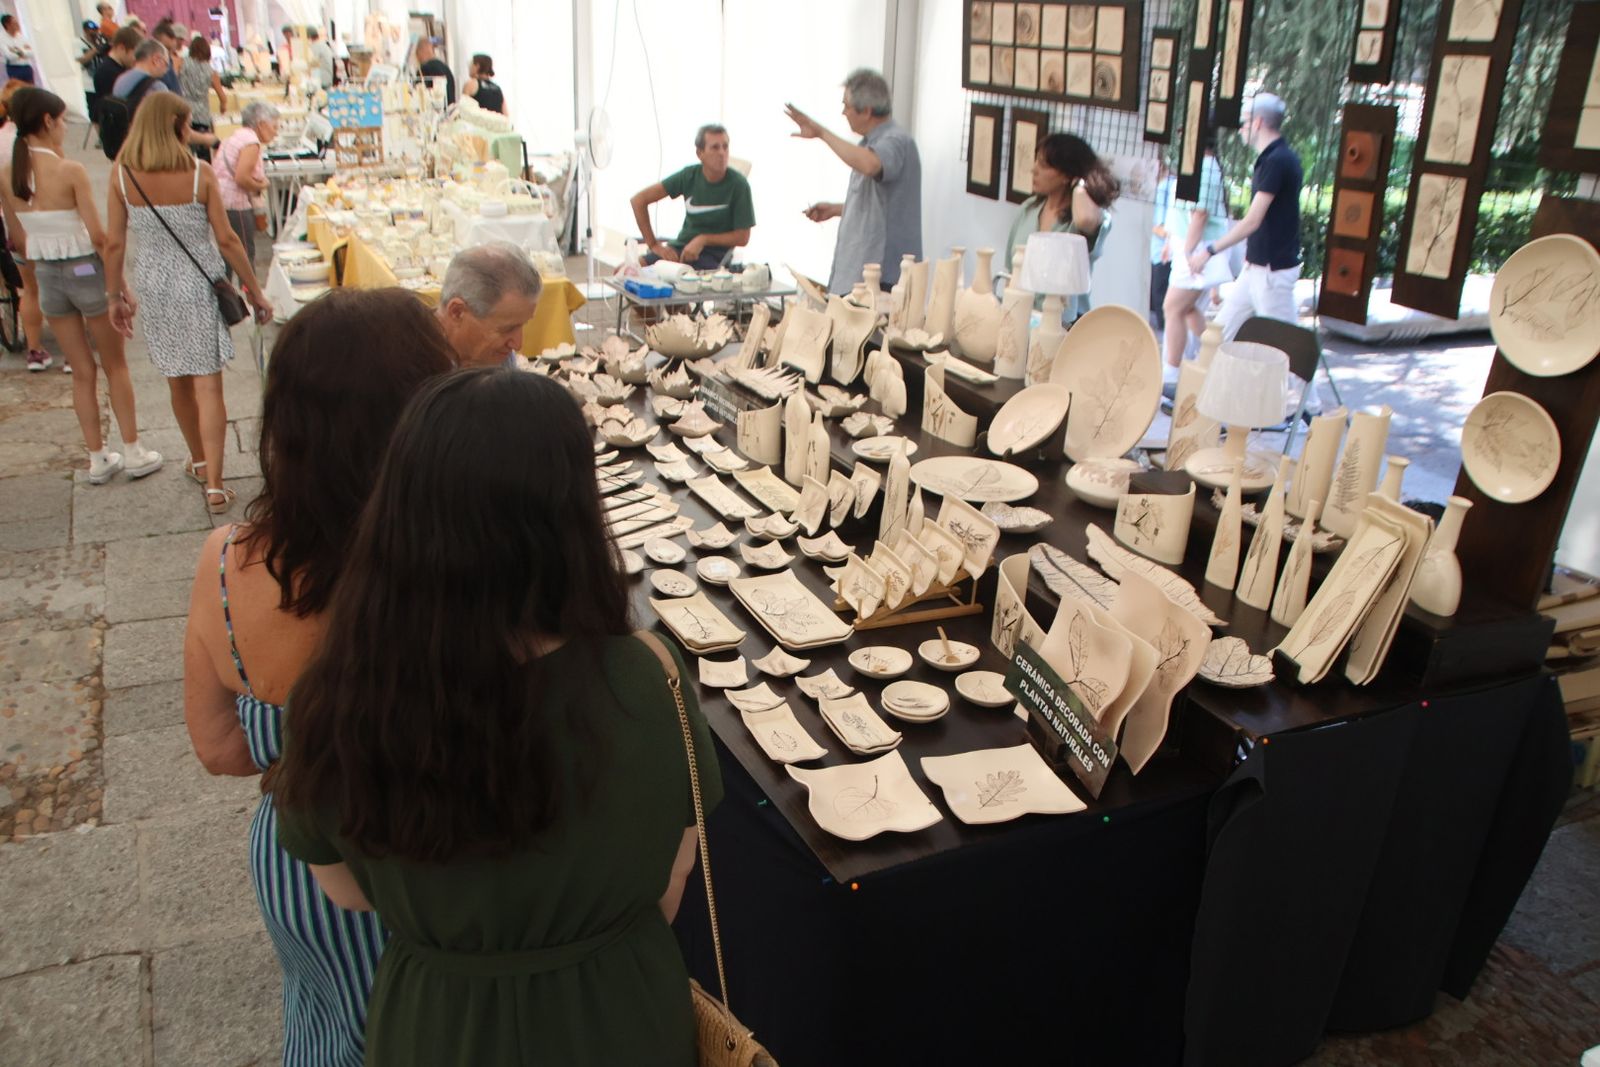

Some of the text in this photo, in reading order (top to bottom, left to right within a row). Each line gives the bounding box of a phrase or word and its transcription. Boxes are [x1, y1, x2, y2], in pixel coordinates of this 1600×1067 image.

[1015, 654, 1111, 769] CERÁMICA DECORADA CON
[1019, 679, 1095, 773] PLANTAS NATURALES
